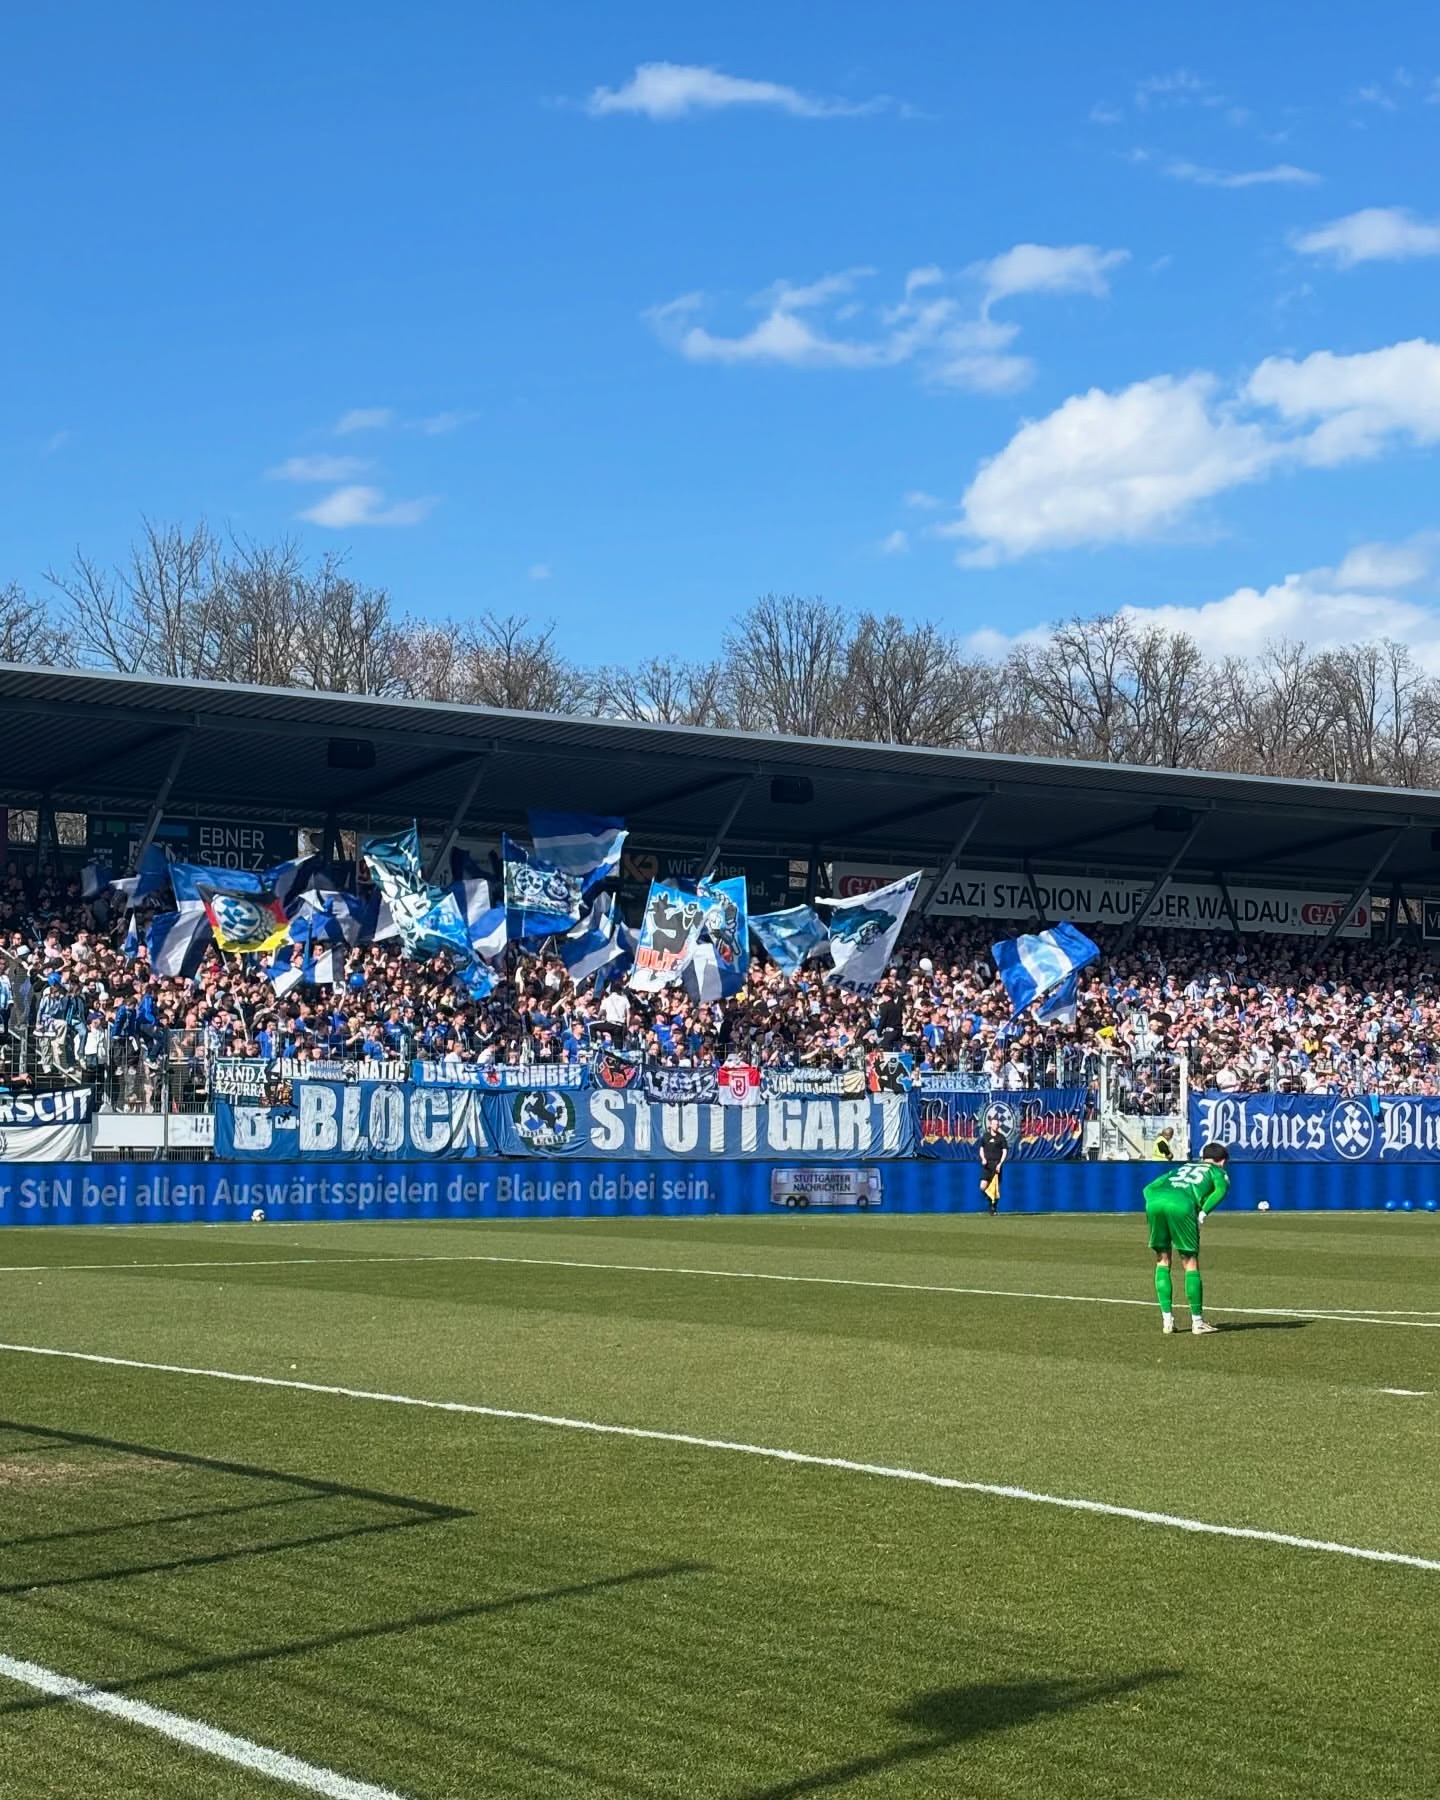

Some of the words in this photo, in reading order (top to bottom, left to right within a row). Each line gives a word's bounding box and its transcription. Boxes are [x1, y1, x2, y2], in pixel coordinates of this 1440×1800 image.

[200, 827, 264, 849] EBNER
[200, 850, 264, 872] STOLZ
[667, 858, 696, 875] Wir
[935, 882, 985, 906] GAZi
[994, 884, 1091, 913] STADION
[1098, 890, 1142, 914] AUF
[1149, 894, 1190, 917] DER
[1195, 896, 1289, 924] WALDAU
[1136, 1015, 1146, 1031] 4
[505, 1063, 582, 1086] BOMBER
[214, 1080, 266, 1097] AZZURRA
[924, 1080, 969, 1090] SHARKS
[589, 1088, 911, 1152] STUTTGART
[1199, 1098, 1326, 1159] Blaues
[793, 1174, 851, 1183] STUTTGARTER
[1168, 1166, 1209, 1184] 35
[19, 1178, 72, 1208] StN
[82, 1176, 128, 1207] bei
[136, 1176, 205, 1207] allen
[212, 1174, 438, 1210] Auswärtsspielen
[447, 1174, 489, 1202] der
[496, 1173, 581, 1202] Blauen
[589, 1173, 655, 1201] dabei
[661, 1173, 716, 1200] sein.
[793, 1183, 851, 1192] NACHRICHTEN
